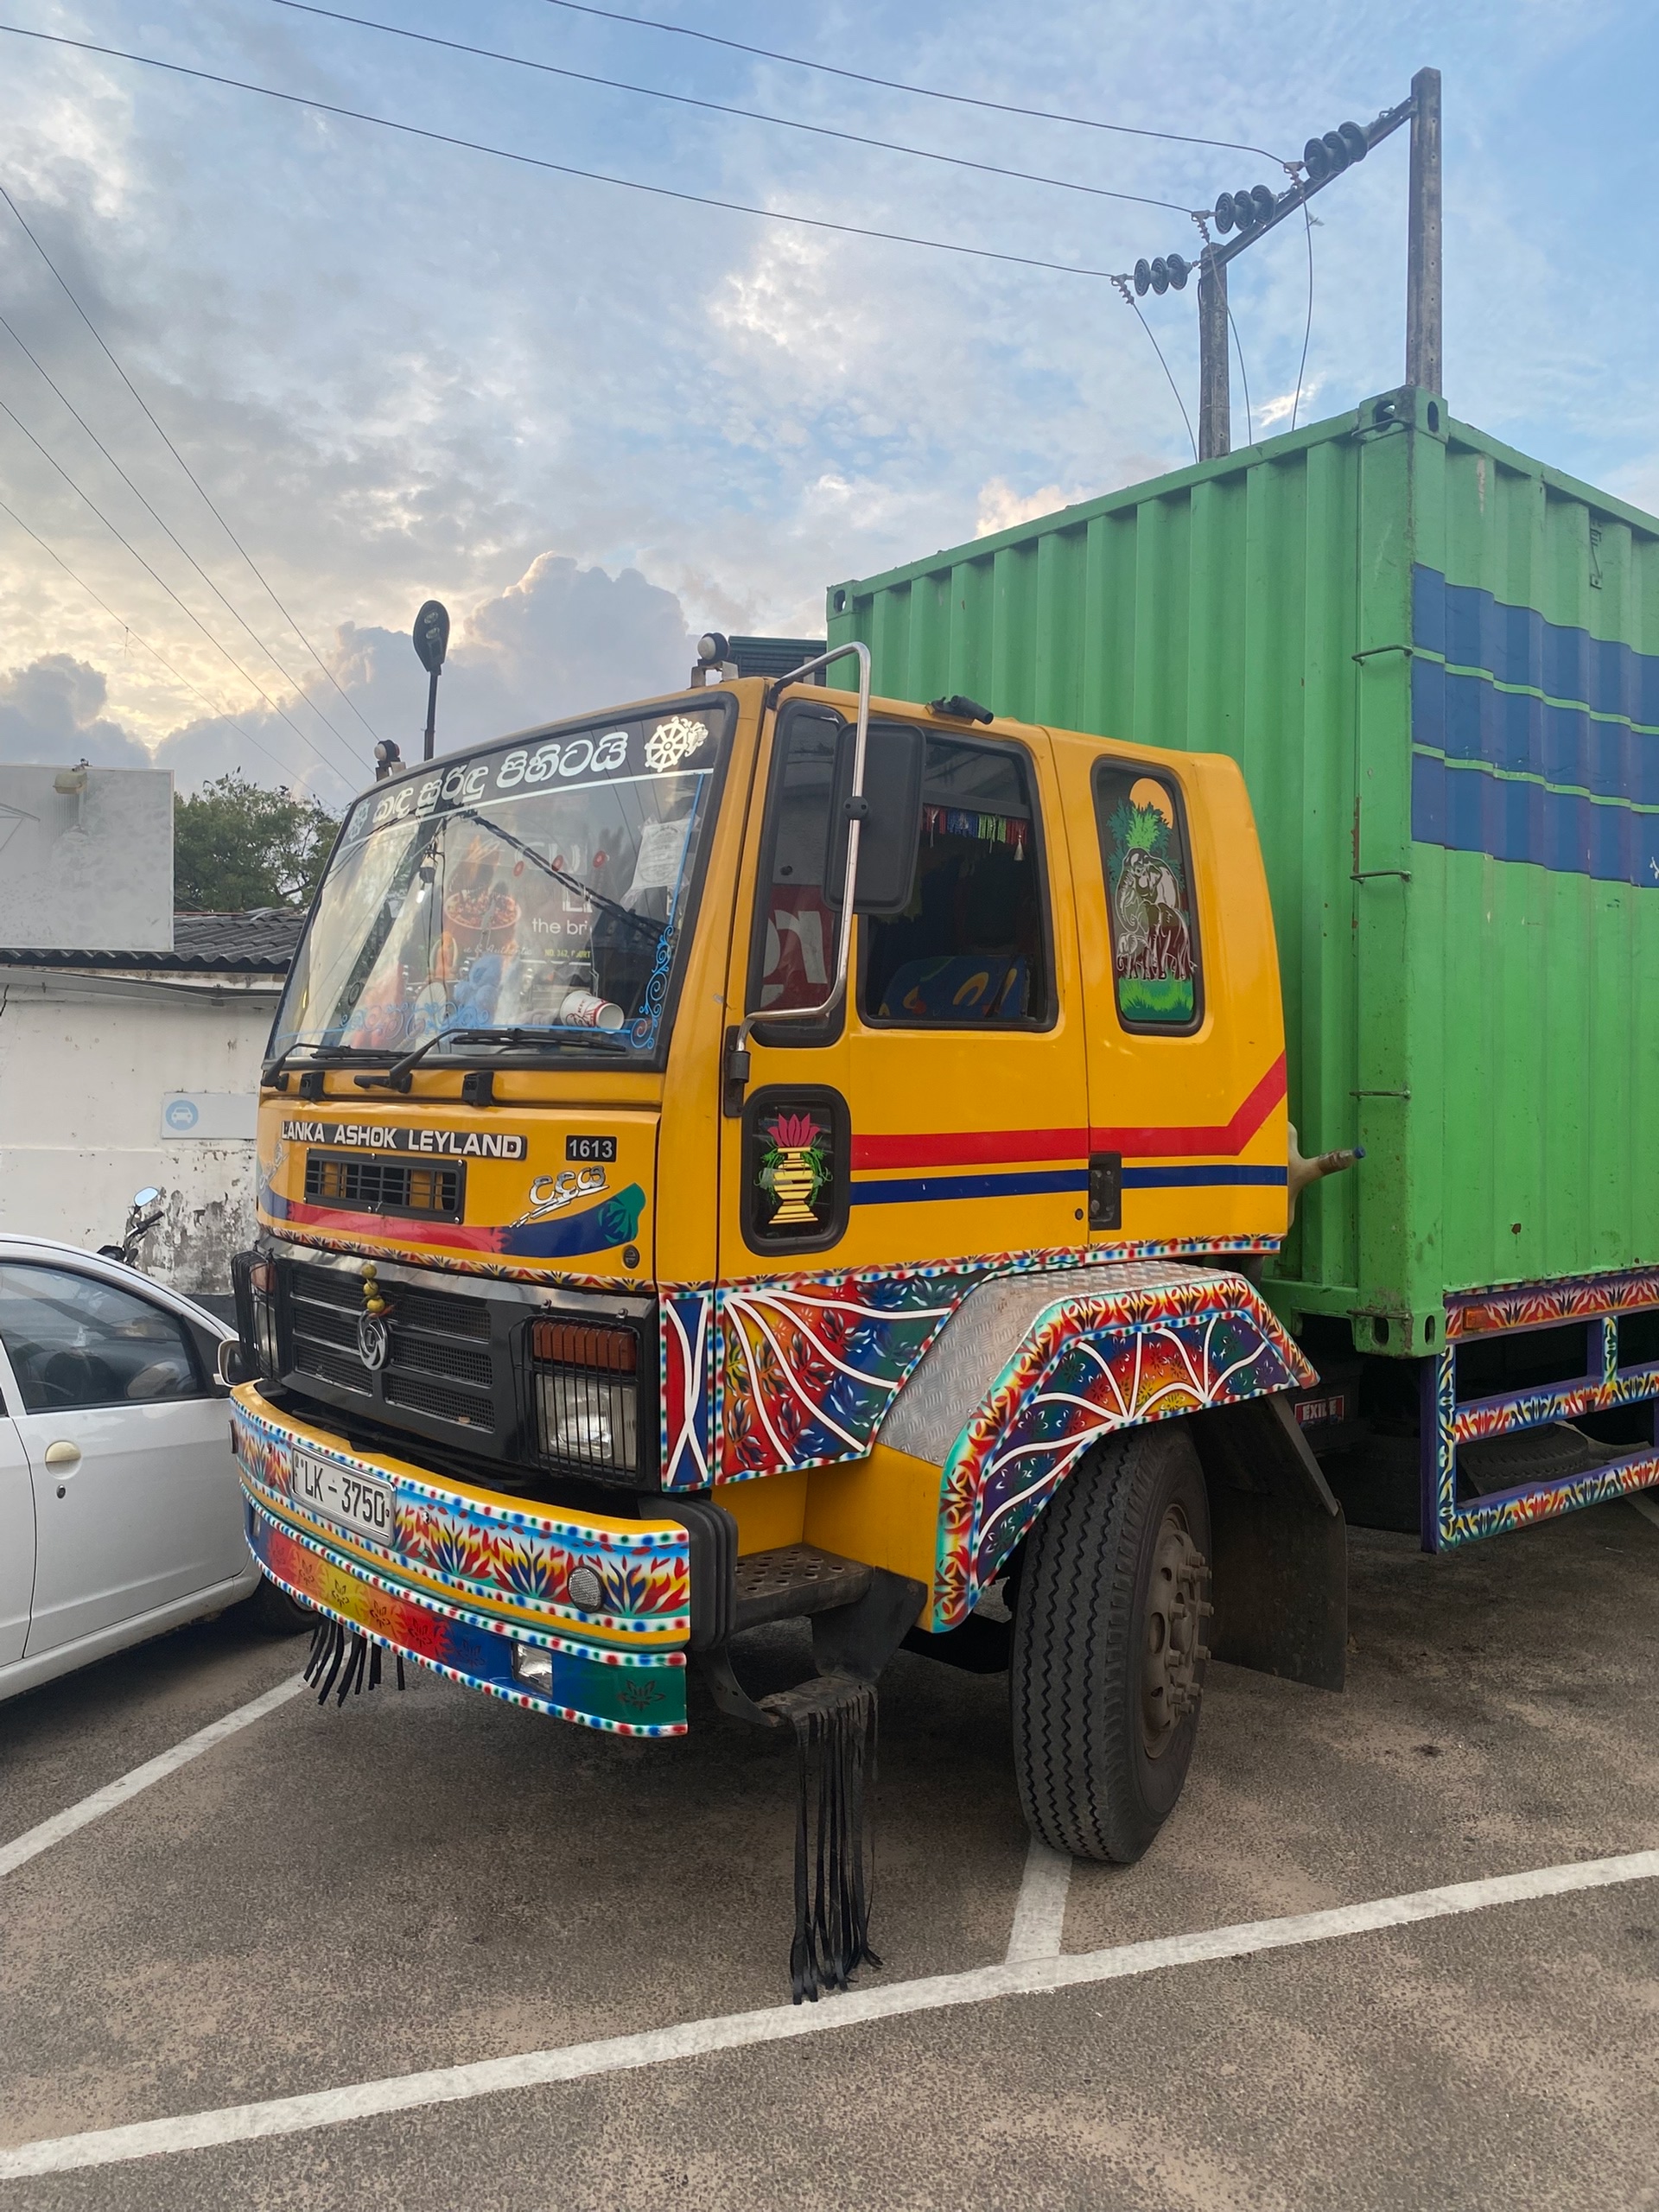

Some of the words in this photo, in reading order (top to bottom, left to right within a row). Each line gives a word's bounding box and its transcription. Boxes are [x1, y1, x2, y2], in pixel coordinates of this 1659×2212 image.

[532, 918, 561, 934] the
[282, 1121, 325, 1142] LANKA
[334, 1124, 397, 1149] ASHOK
[408, 1128, 522, 1159] LEYLAND
[569, 1140, 613, 1159] 1613
